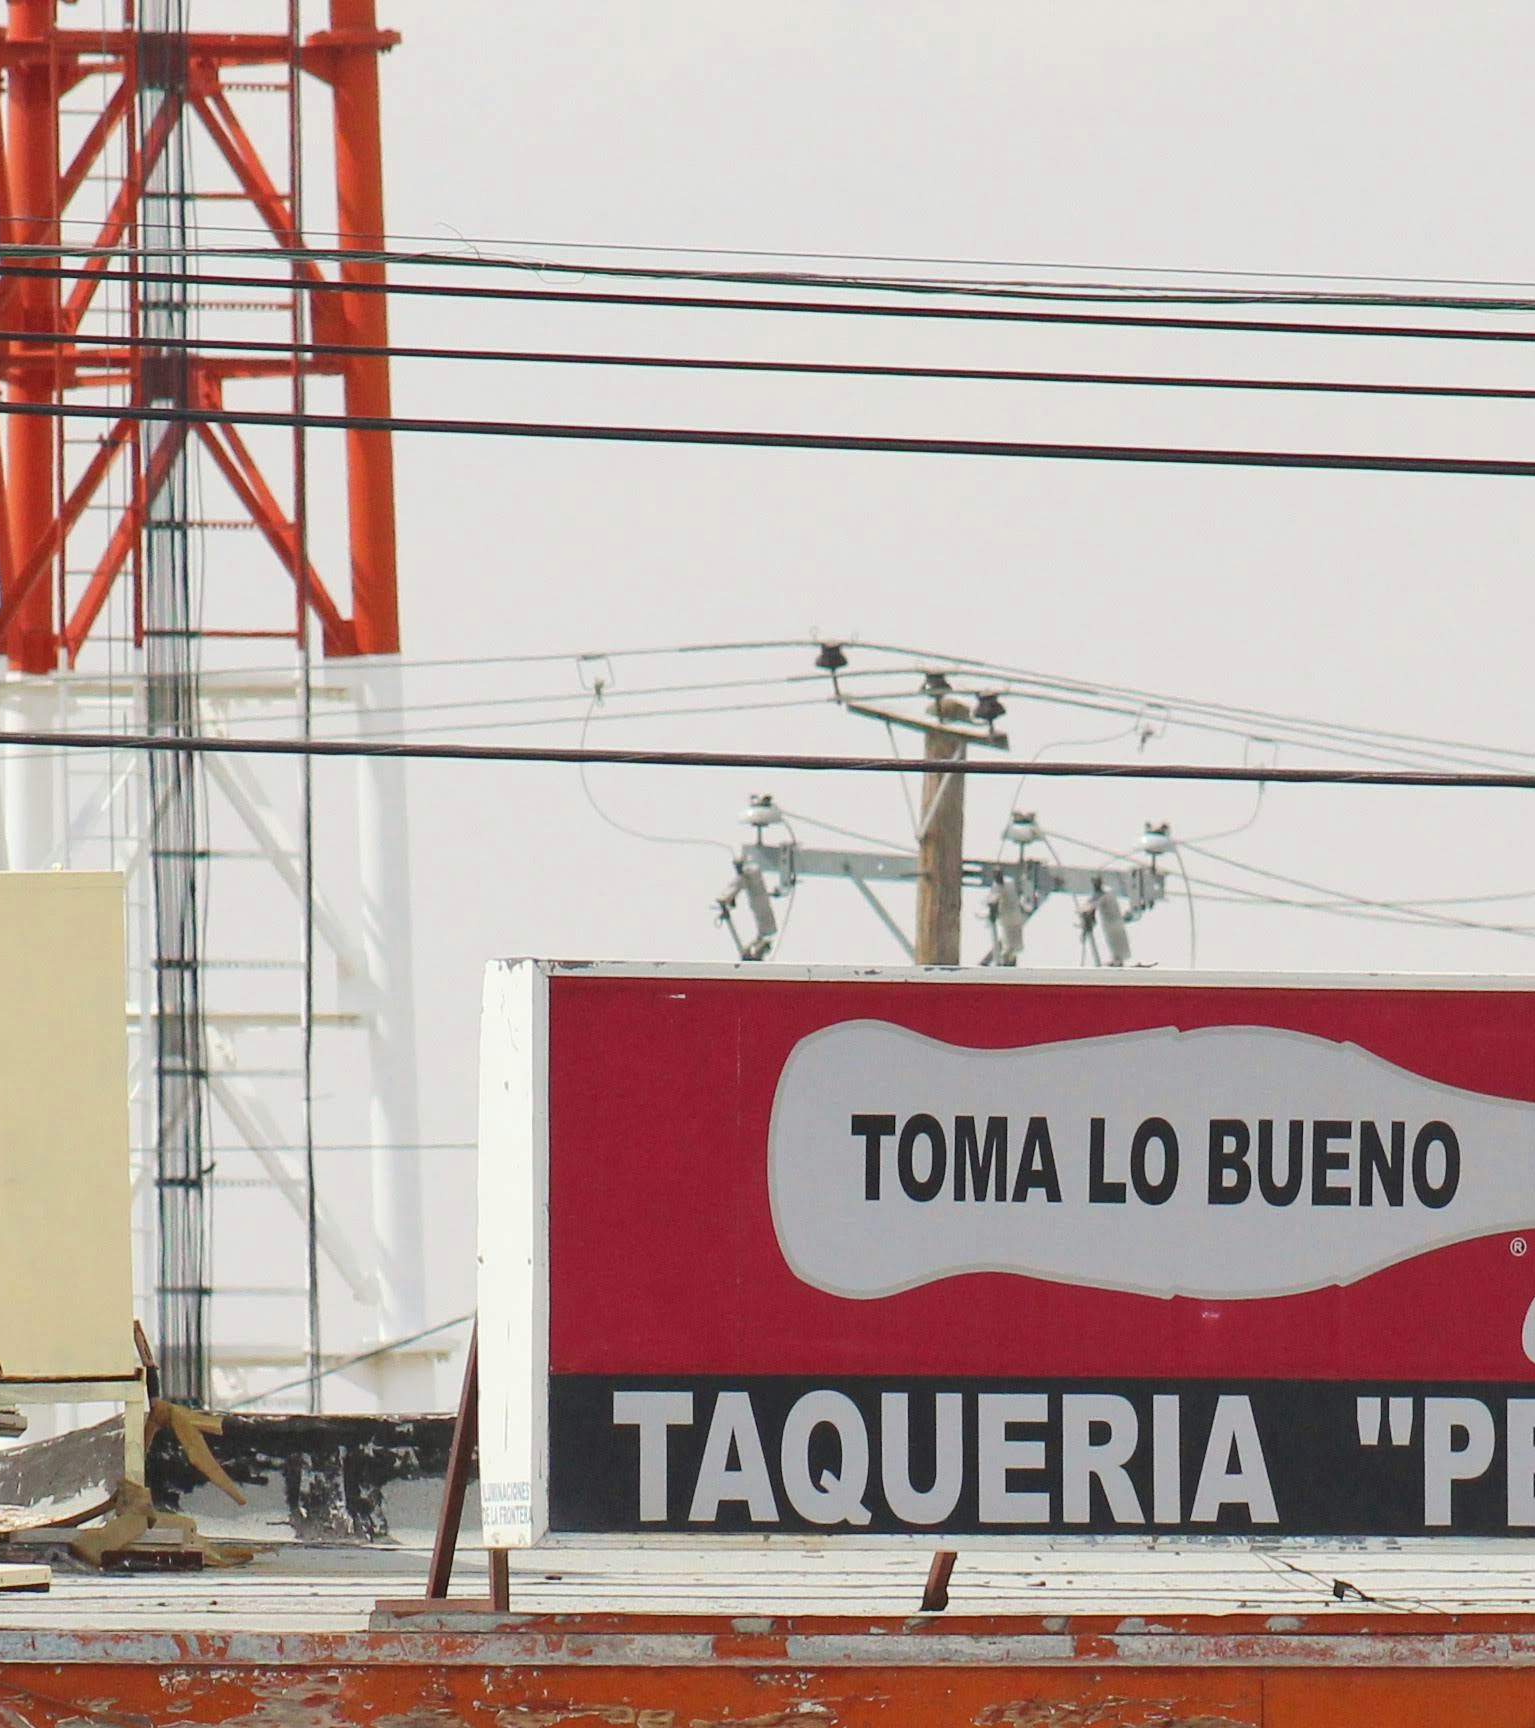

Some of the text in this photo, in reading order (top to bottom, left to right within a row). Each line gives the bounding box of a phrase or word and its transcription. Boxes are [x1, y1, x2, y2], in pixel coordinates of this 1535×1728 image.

[850, 1113, 1462, 1210] TOMA LO BUENO
[612, 1389, 1281, 1526] TAQUERIA
